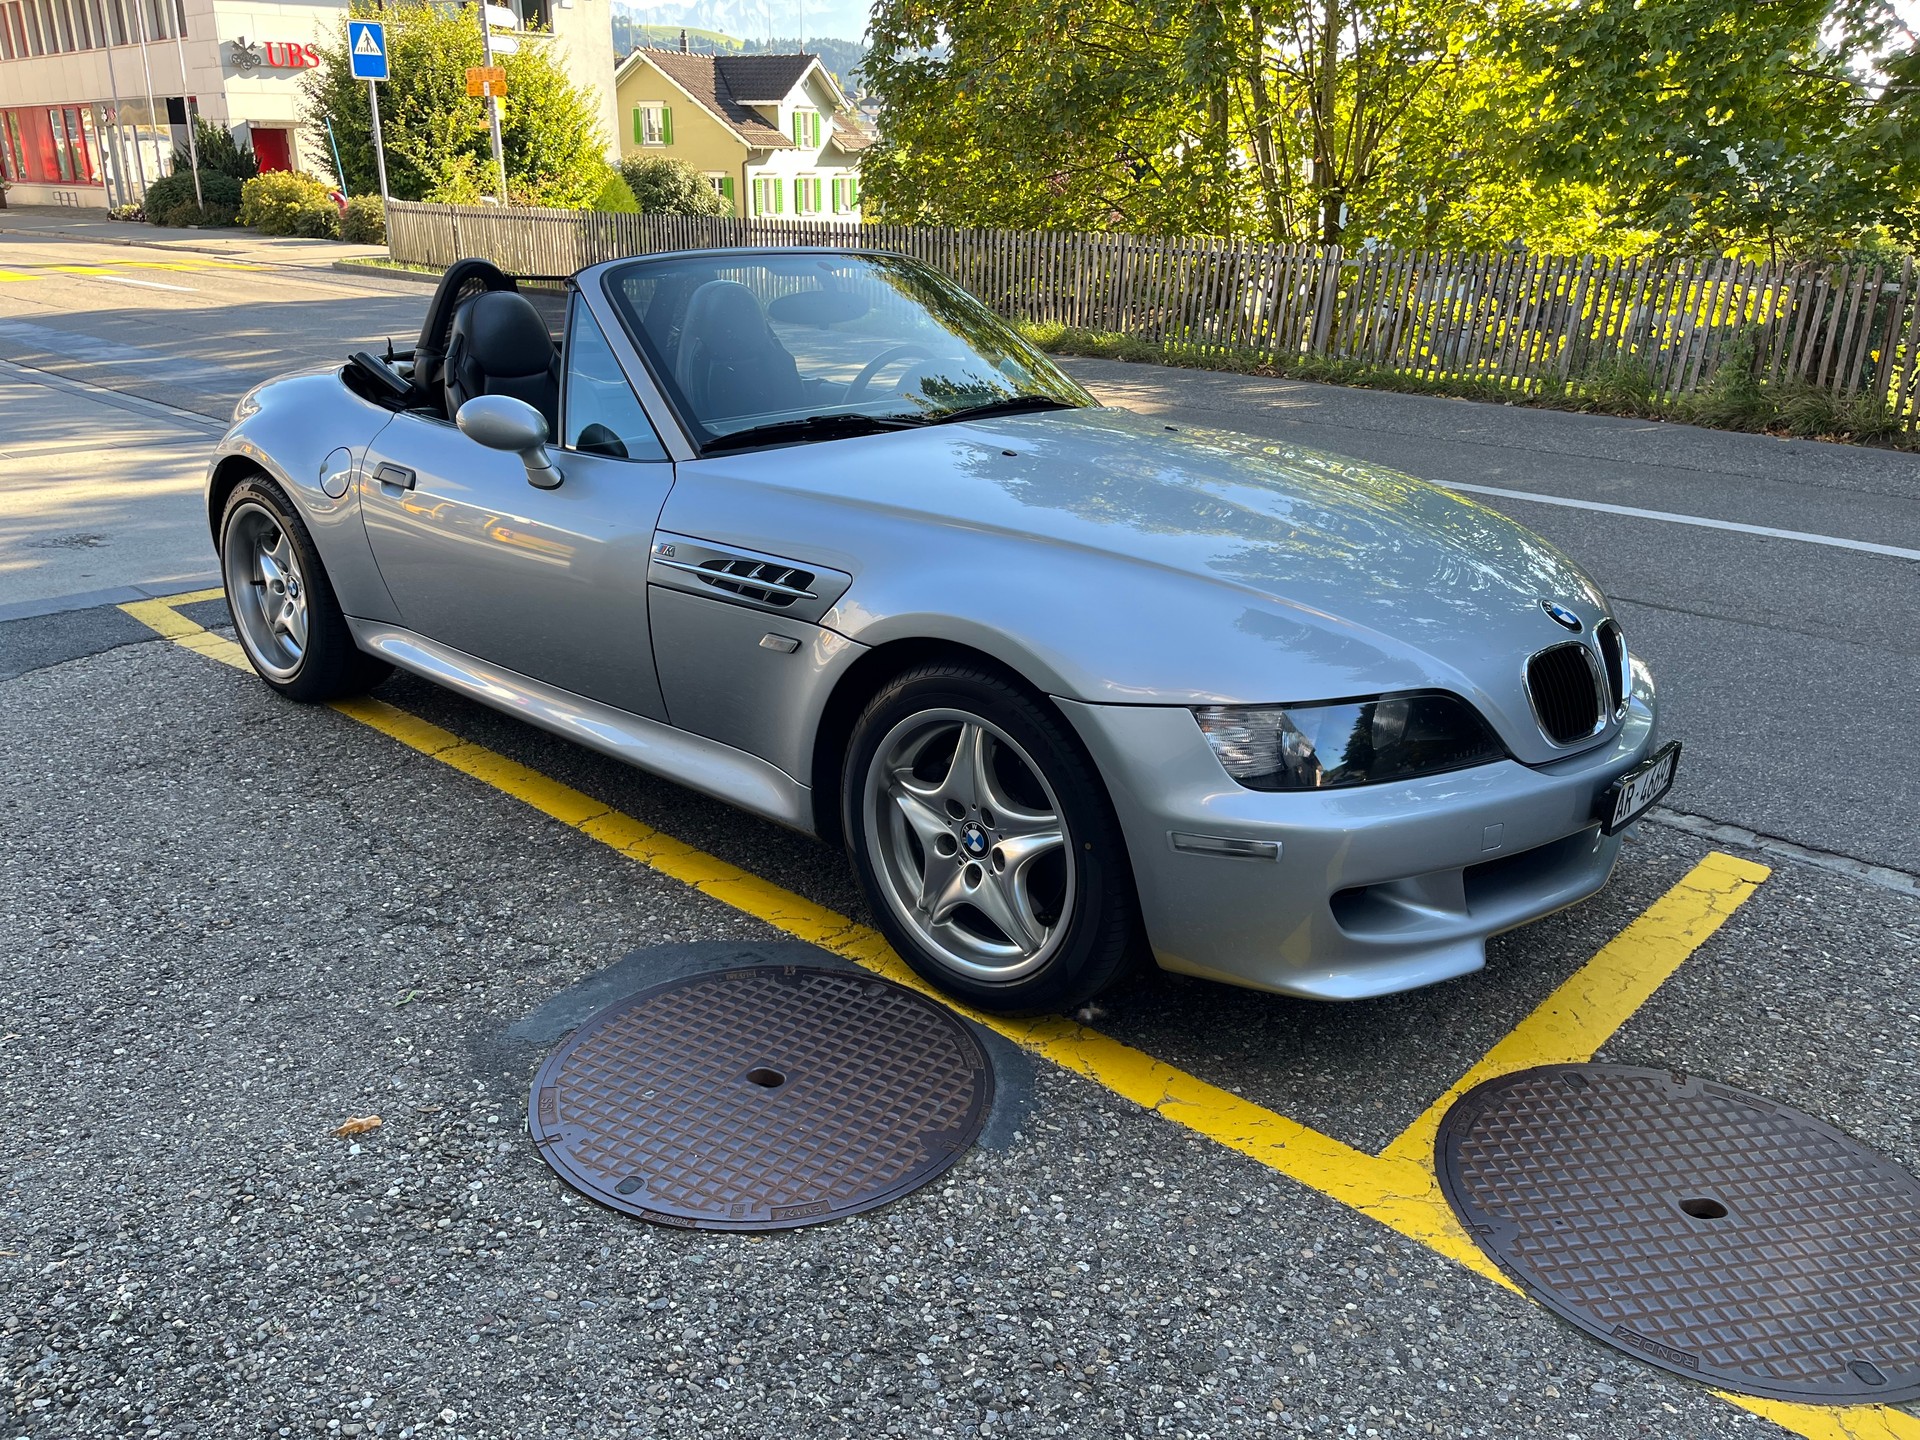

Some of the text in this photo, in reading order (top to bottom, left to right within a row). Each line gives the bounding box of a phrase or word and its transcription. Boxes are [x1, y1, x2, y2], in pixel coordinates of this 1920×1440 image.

[263, 42, 319, 68] UBS
[1726, 1091, 1754, 1106] VSS
[648, 1212, 689, 1226] RONDEZ
[1616, 1328, 1696, 1368] RONDEZ
